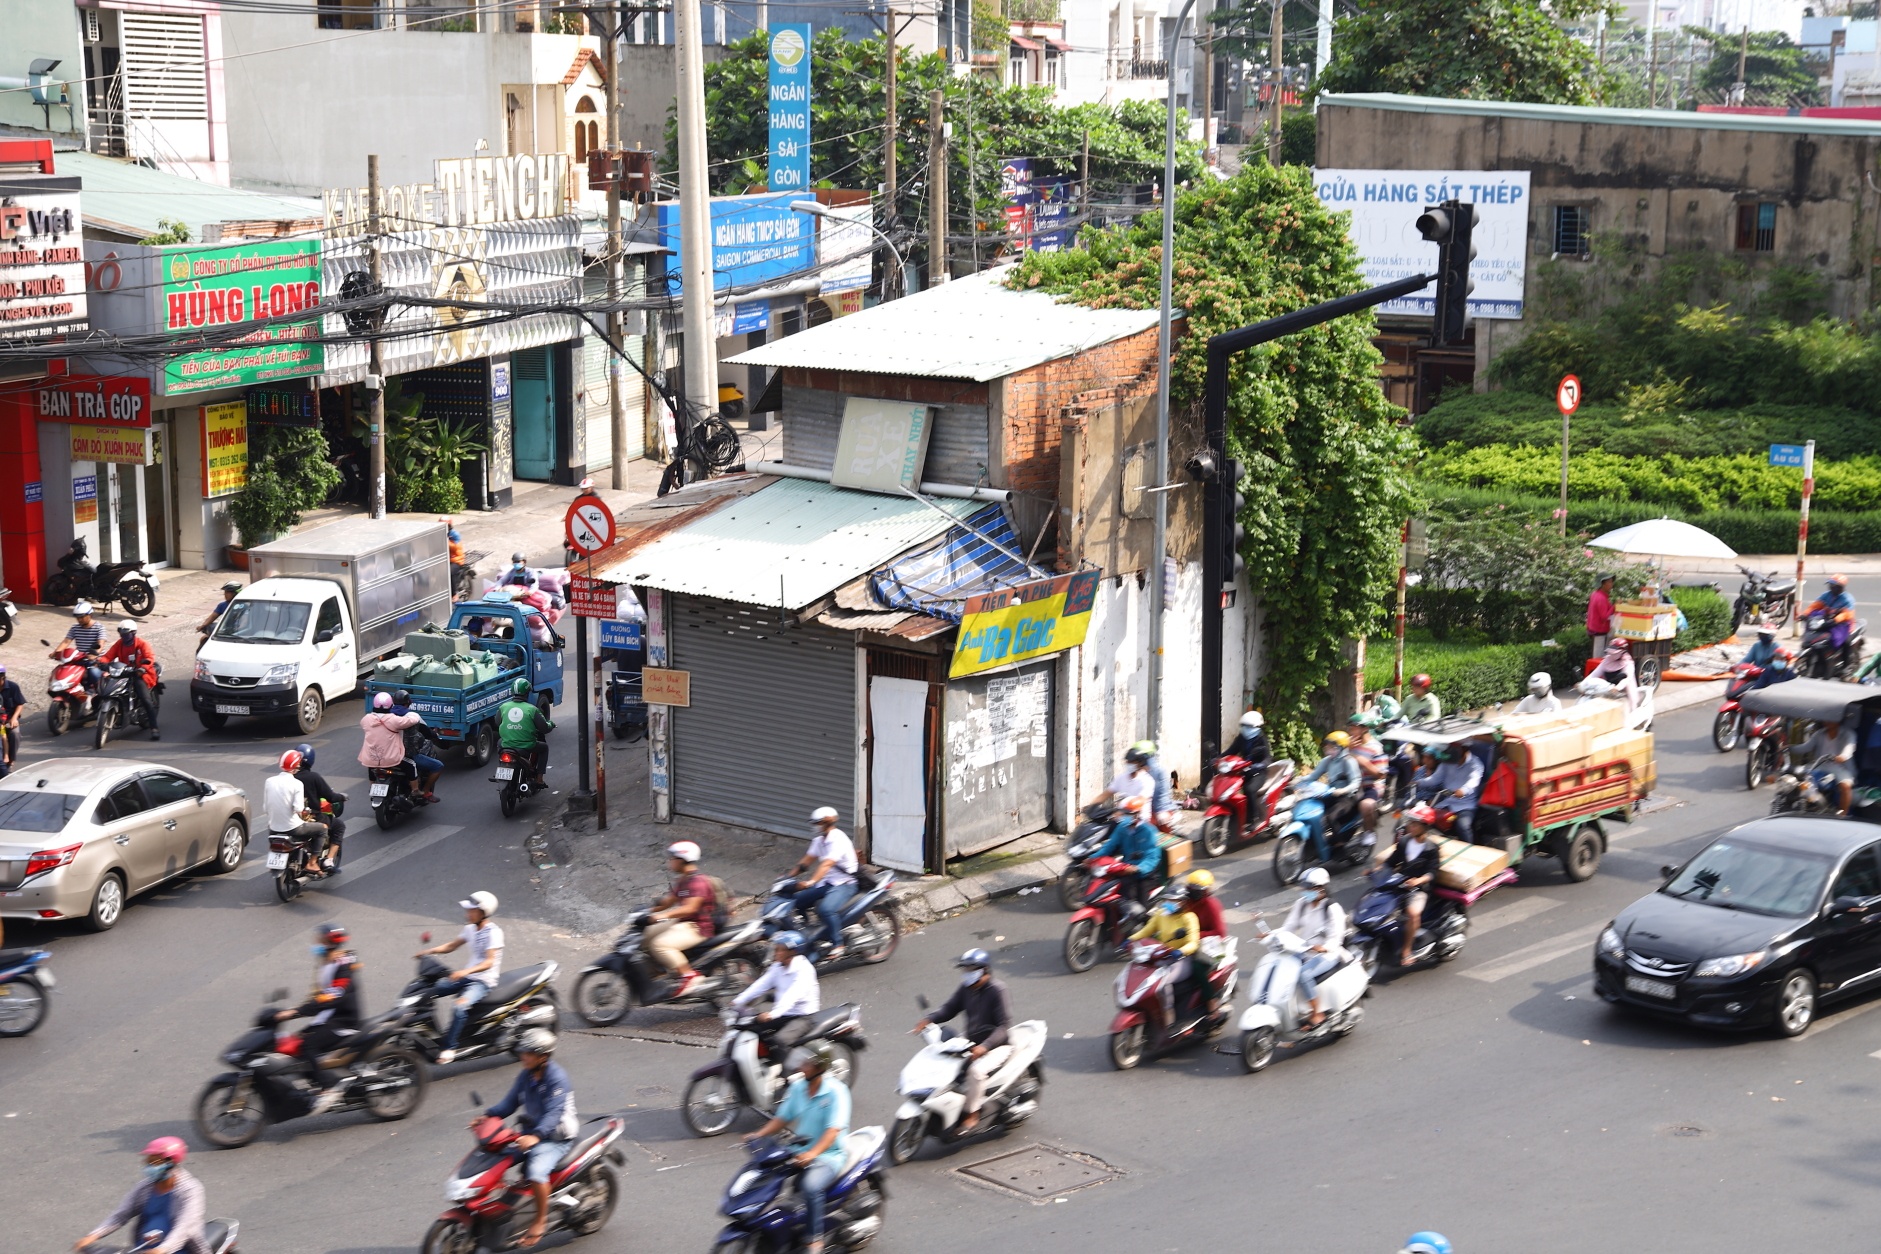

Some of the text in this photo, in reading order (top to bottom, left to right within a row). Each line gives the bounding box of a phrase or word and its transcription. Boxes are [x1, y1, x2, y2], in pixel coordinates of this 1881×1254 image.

[771, 81, 805, 101] NGÂN
[771, 109, 805, 129] HÀNG
[778, 137, 797, 158] SÀI
[774, 165, 801, 185] GÒN
[1319, 175, 1523, 204] CỬA HÀNG SẮT THÉP
[716, 219, 736, 246] NGÂN
[736, 217, 756, 244] HÀNG
[46, 247, 81, 263] CAMERA
[716, 244, 799, 268] SAIGON COMMERCIAL BANK
[194, 256, 216, 275] CÔNG
[218, 259, 228, 274] TY
[167, 280, 320, 330] HÙNG LONG
[39, 382, 142, 420] BÁN TRẢ GÓP
[495, 385, 508, 397] 900
[104, 438, 123, 455] XUÂN
[876, 420, 905, 474] XE
[901, 446, 918, 481] THAY
[626, 634, 639, 645] BÍCH
[959, 628, 984, 652] Anh
[978, 625, 1012, 664] Ba
[417, 703, 430, 711] 0937
[443, 706, 454, 714] 646
